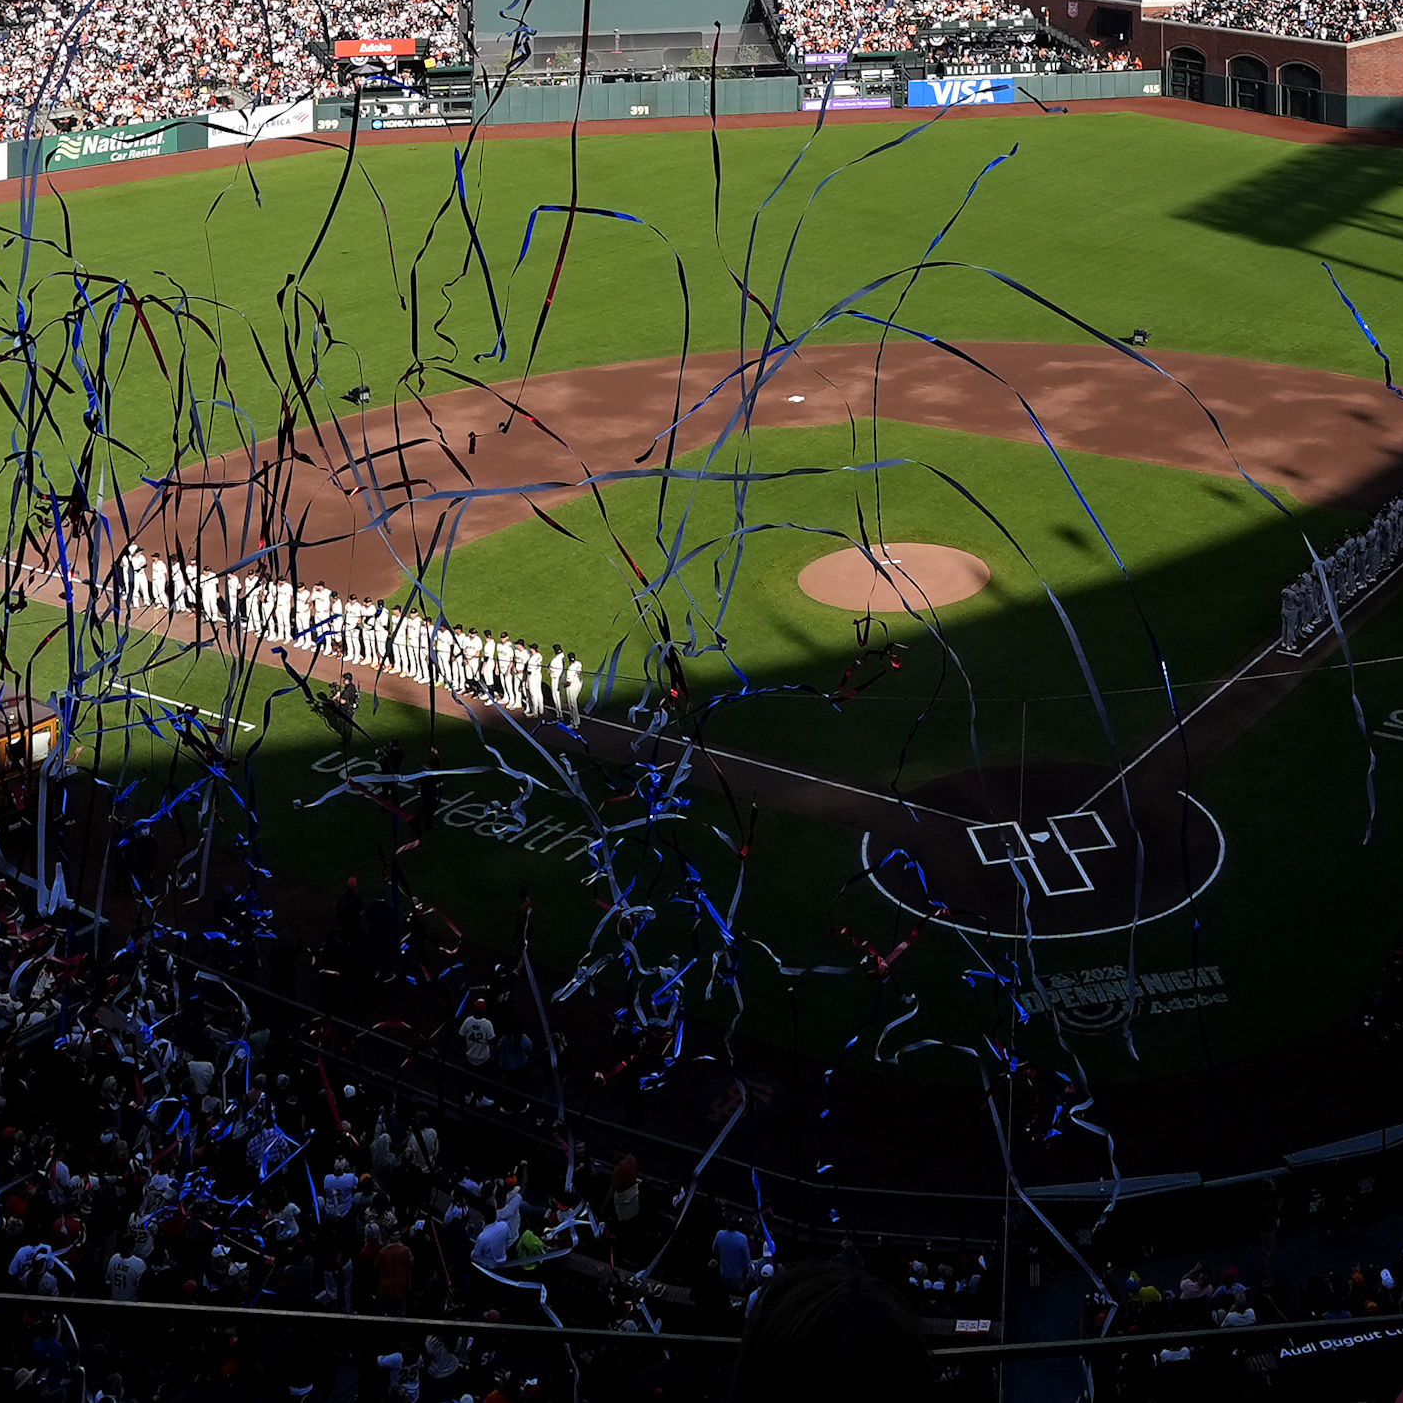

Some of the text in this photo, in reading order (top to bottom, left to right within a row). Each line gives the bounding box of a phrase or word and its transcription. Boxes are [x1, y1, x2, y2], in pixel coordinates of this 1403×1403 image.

[359, 43, 392, 53] Adobe
[946, 65, 992, 75] WELCOME
[1000, 63, 1011, 73] TO
[1020, 62, 1036, 72] THE
[927, 80, 995, 104] VISA
[1142, 84, 1161, 94] 415
[630, 106, 649, 115] 391
[317, 119, 339, 130] 399
[383, 119, 447, 129] KONICA MINOLTA
[81, 131, 164, 156] National
[110, 146, 161, 162] Car Rental
[1138, 966, 1225, 996] NIGHT
[1150, 992, 1229, 1015] Adobe
[114, 1274, 127, 1287] 51
[1279, 1342, 1318, 1359] Audi
[1319, 1330, 1382, 1351] Dugout
